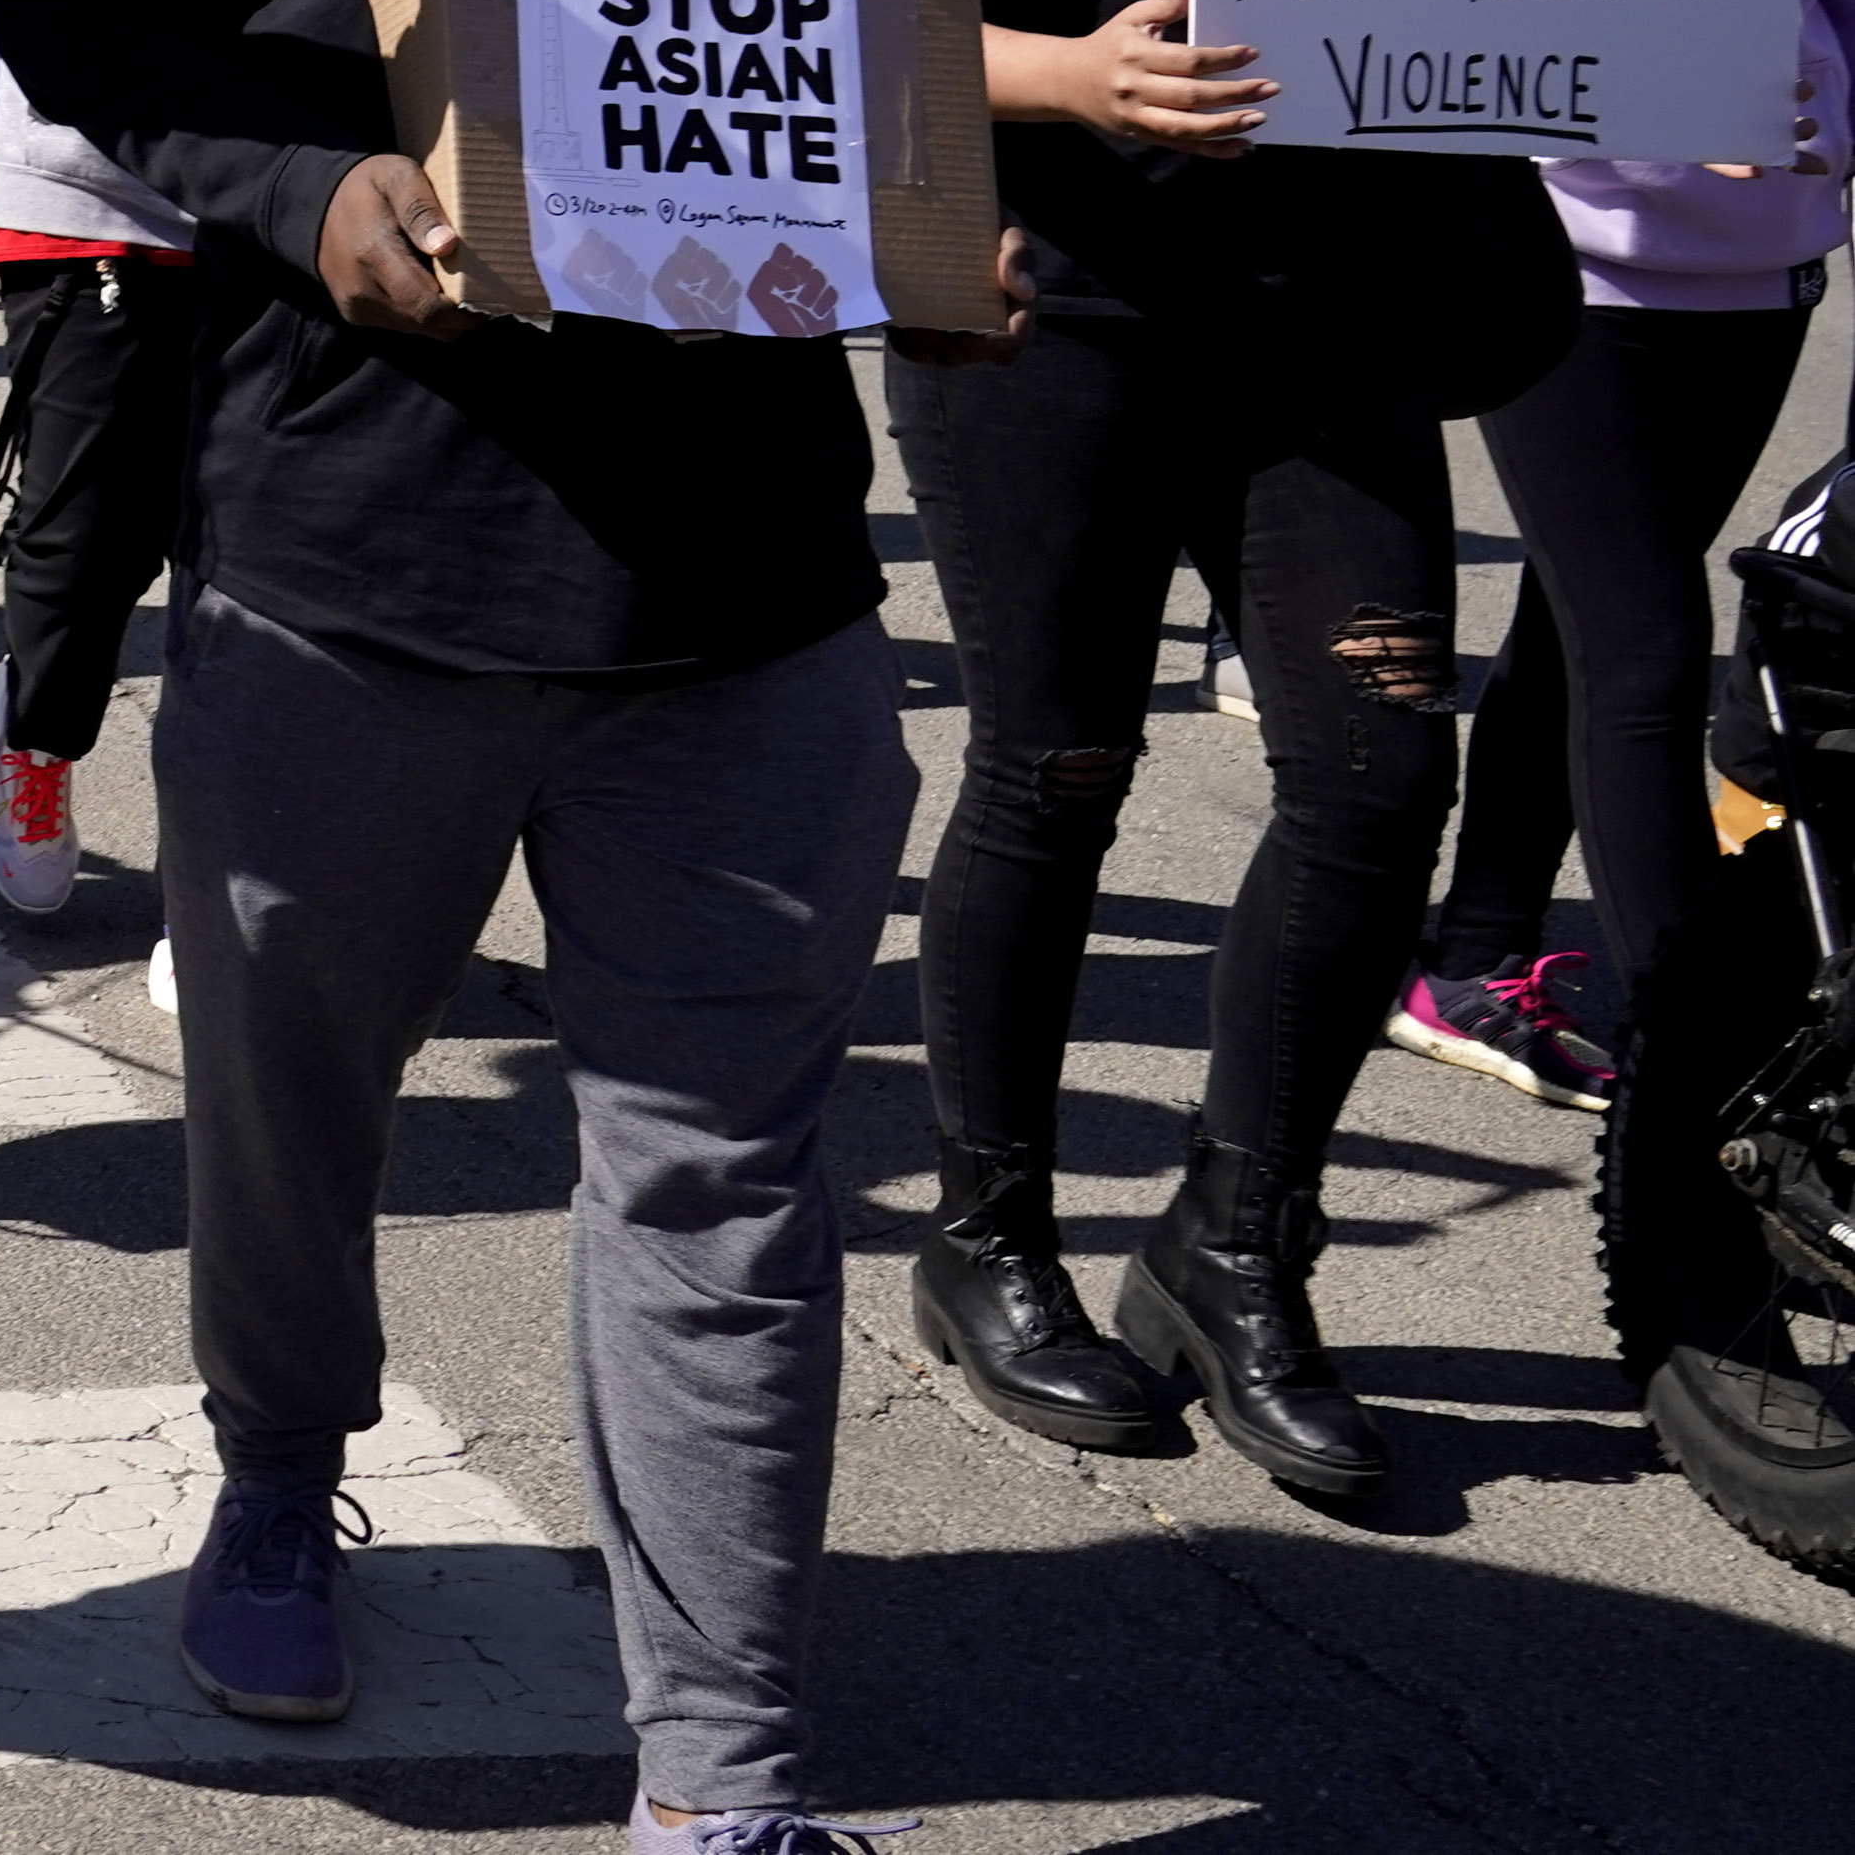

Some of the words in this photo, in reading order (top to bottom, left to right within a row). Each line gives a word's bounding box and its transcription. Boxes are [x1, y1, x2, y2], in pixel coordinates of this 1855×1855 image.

[599, 34, 837, 106] ASIAN
[1323, 34, 1601, 125] VIOLENCE
[601, 102, 842, 185] HATE
